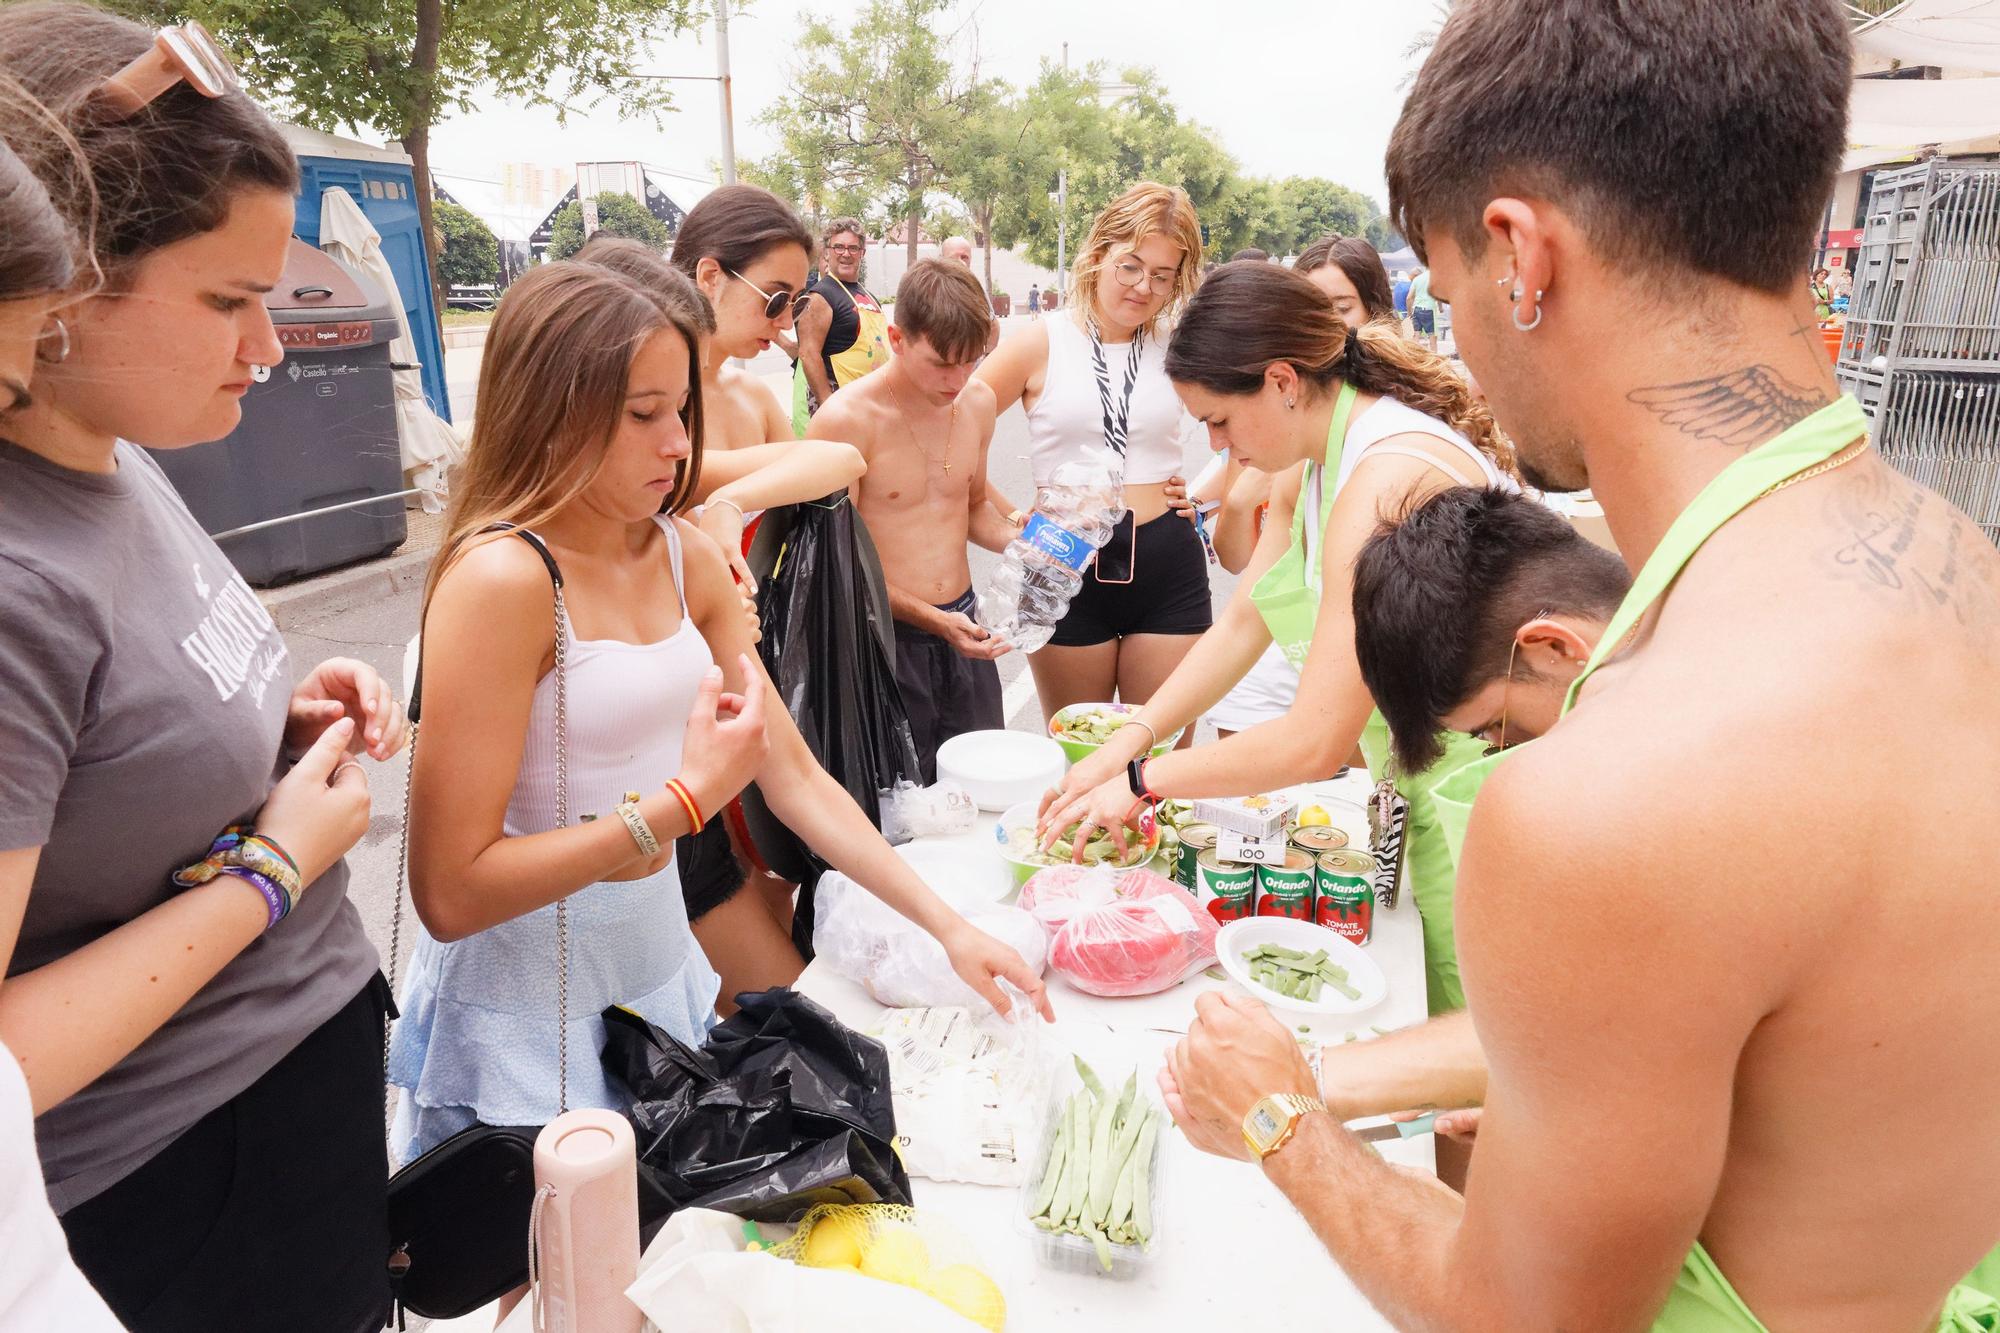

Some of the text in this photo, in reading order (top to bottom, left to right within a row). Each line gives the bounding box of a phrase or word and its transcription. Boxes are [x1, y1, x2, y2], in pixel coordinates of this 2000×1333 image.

[1265, 877, 1310, 890] Orlando
[1321, 878, 1367, 894] Orlando
[1325, 919, 1358, 930] TOMATE
